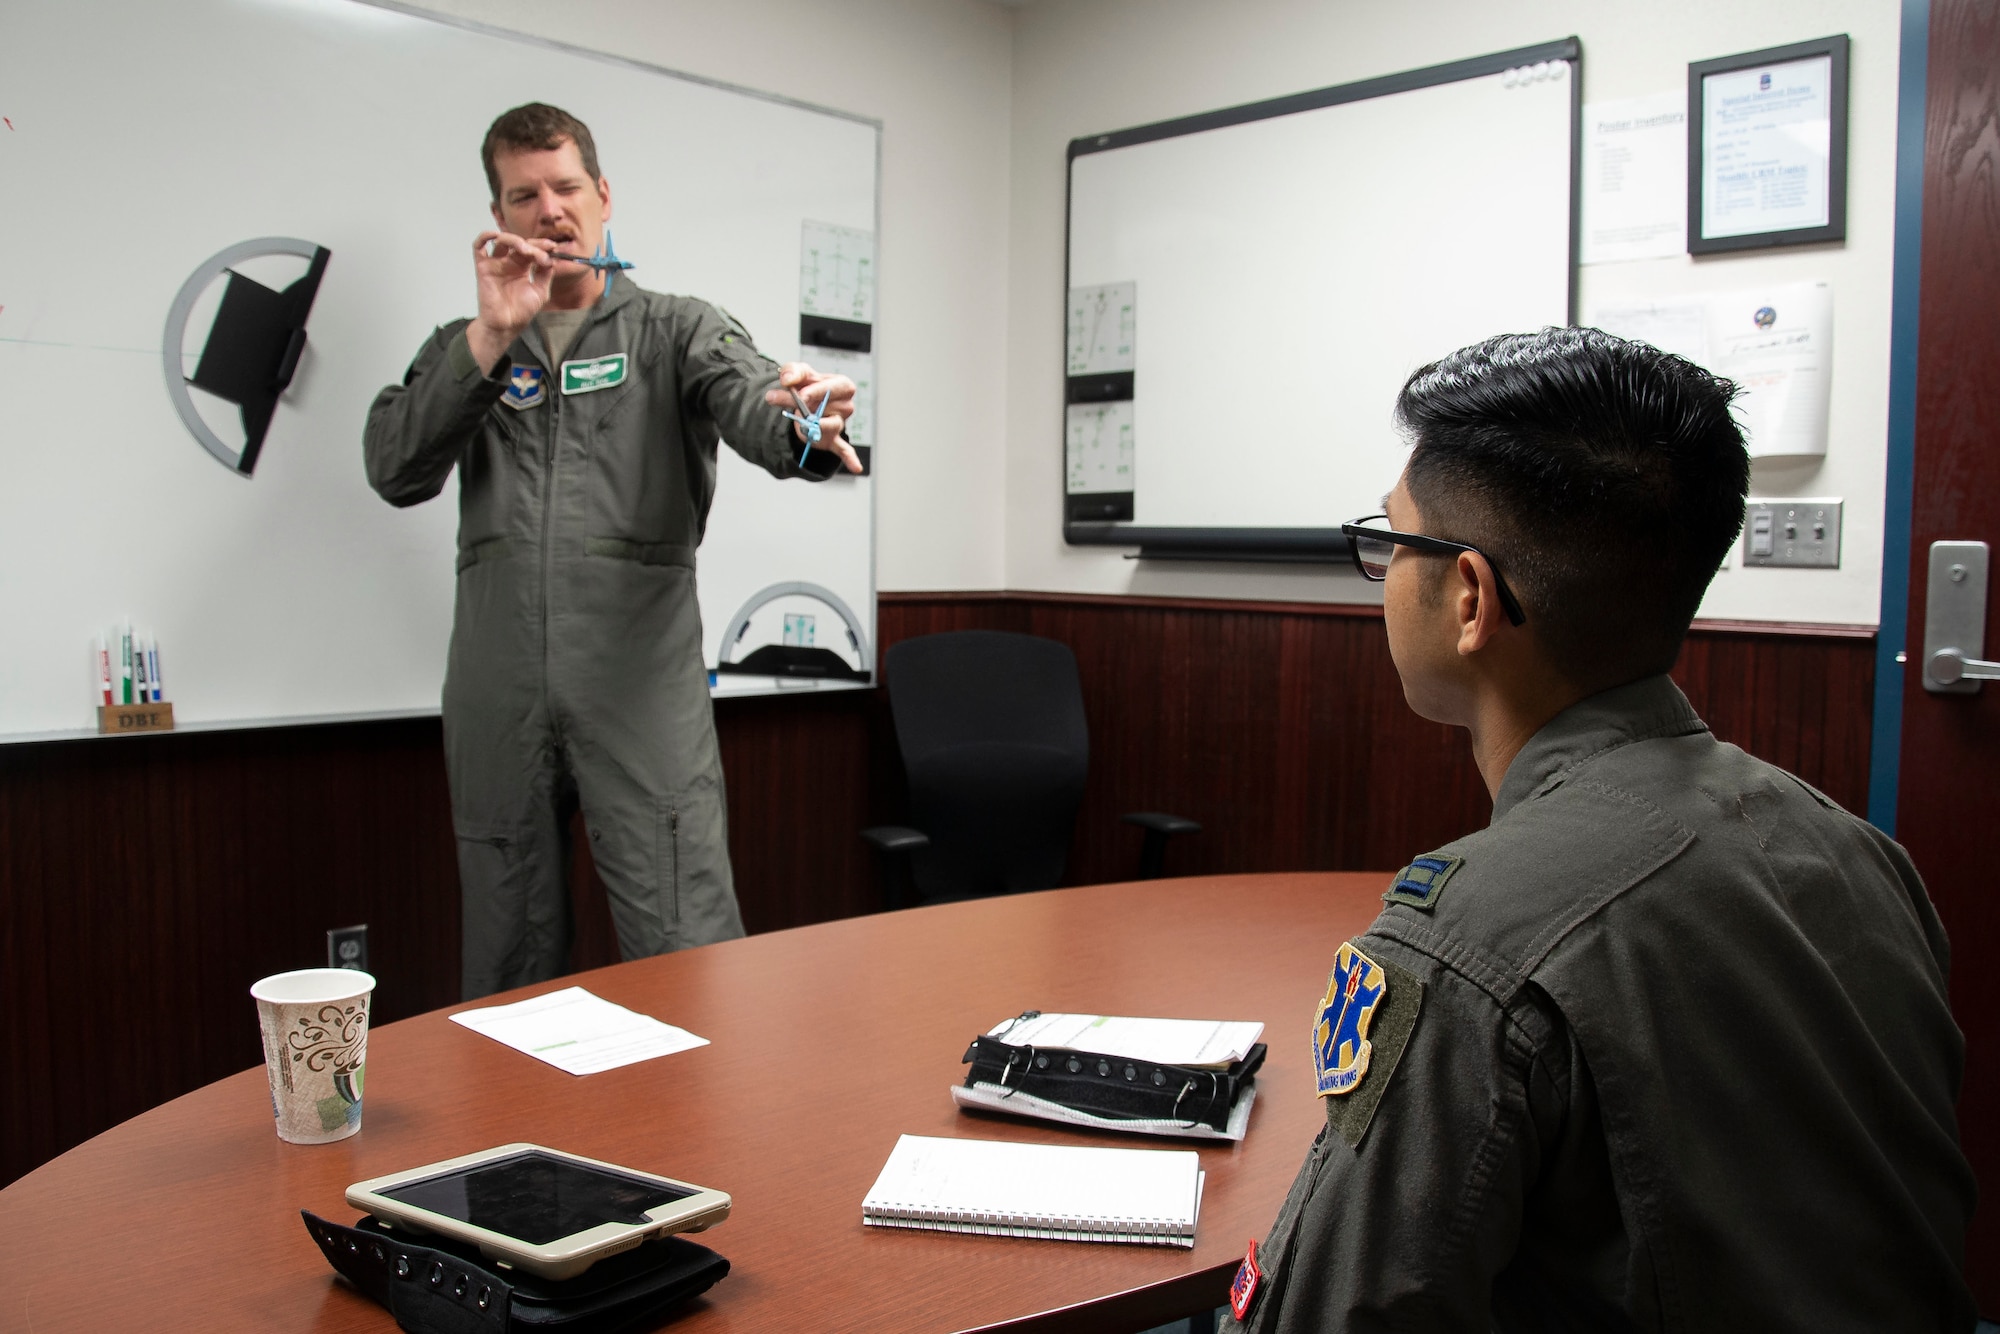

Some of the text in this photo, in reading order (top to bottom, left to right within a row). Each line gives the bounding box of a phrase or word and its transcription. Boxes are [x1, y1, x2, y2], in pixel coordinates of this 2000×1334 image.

[1597, 111, 1684, 132] Poster Inventory
[1340, 1069, 1356, 1086] WING
